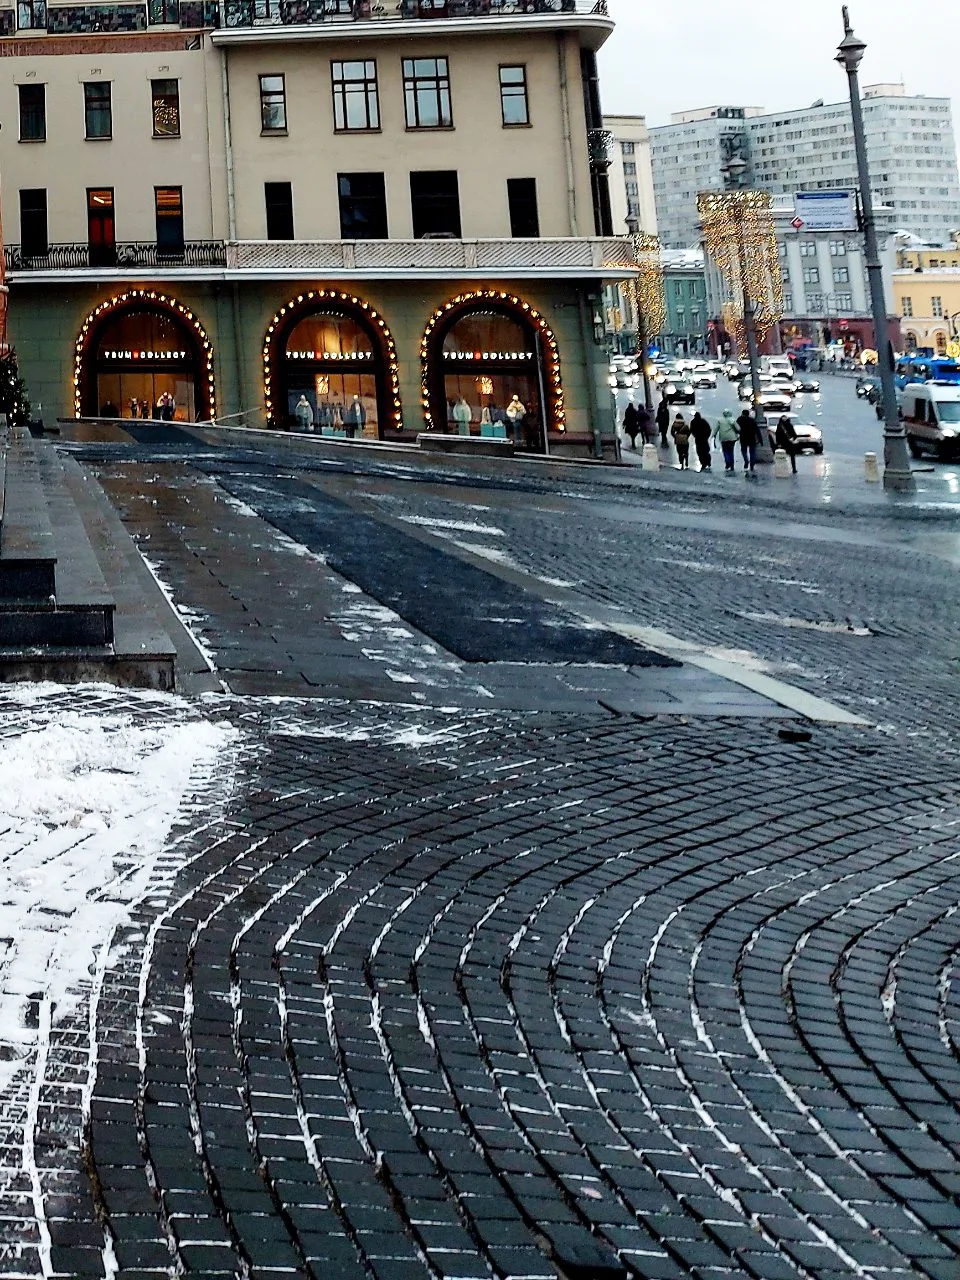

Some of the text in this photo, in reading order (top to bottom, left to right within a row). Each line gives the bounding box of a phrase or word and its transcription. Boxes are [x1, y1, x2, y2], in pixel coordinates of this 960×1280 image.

[140, 350, 186, 359] COLLECT
[323, 351, 372, 360] COLLECT
[482, 351, 533, 360] COLLECT
